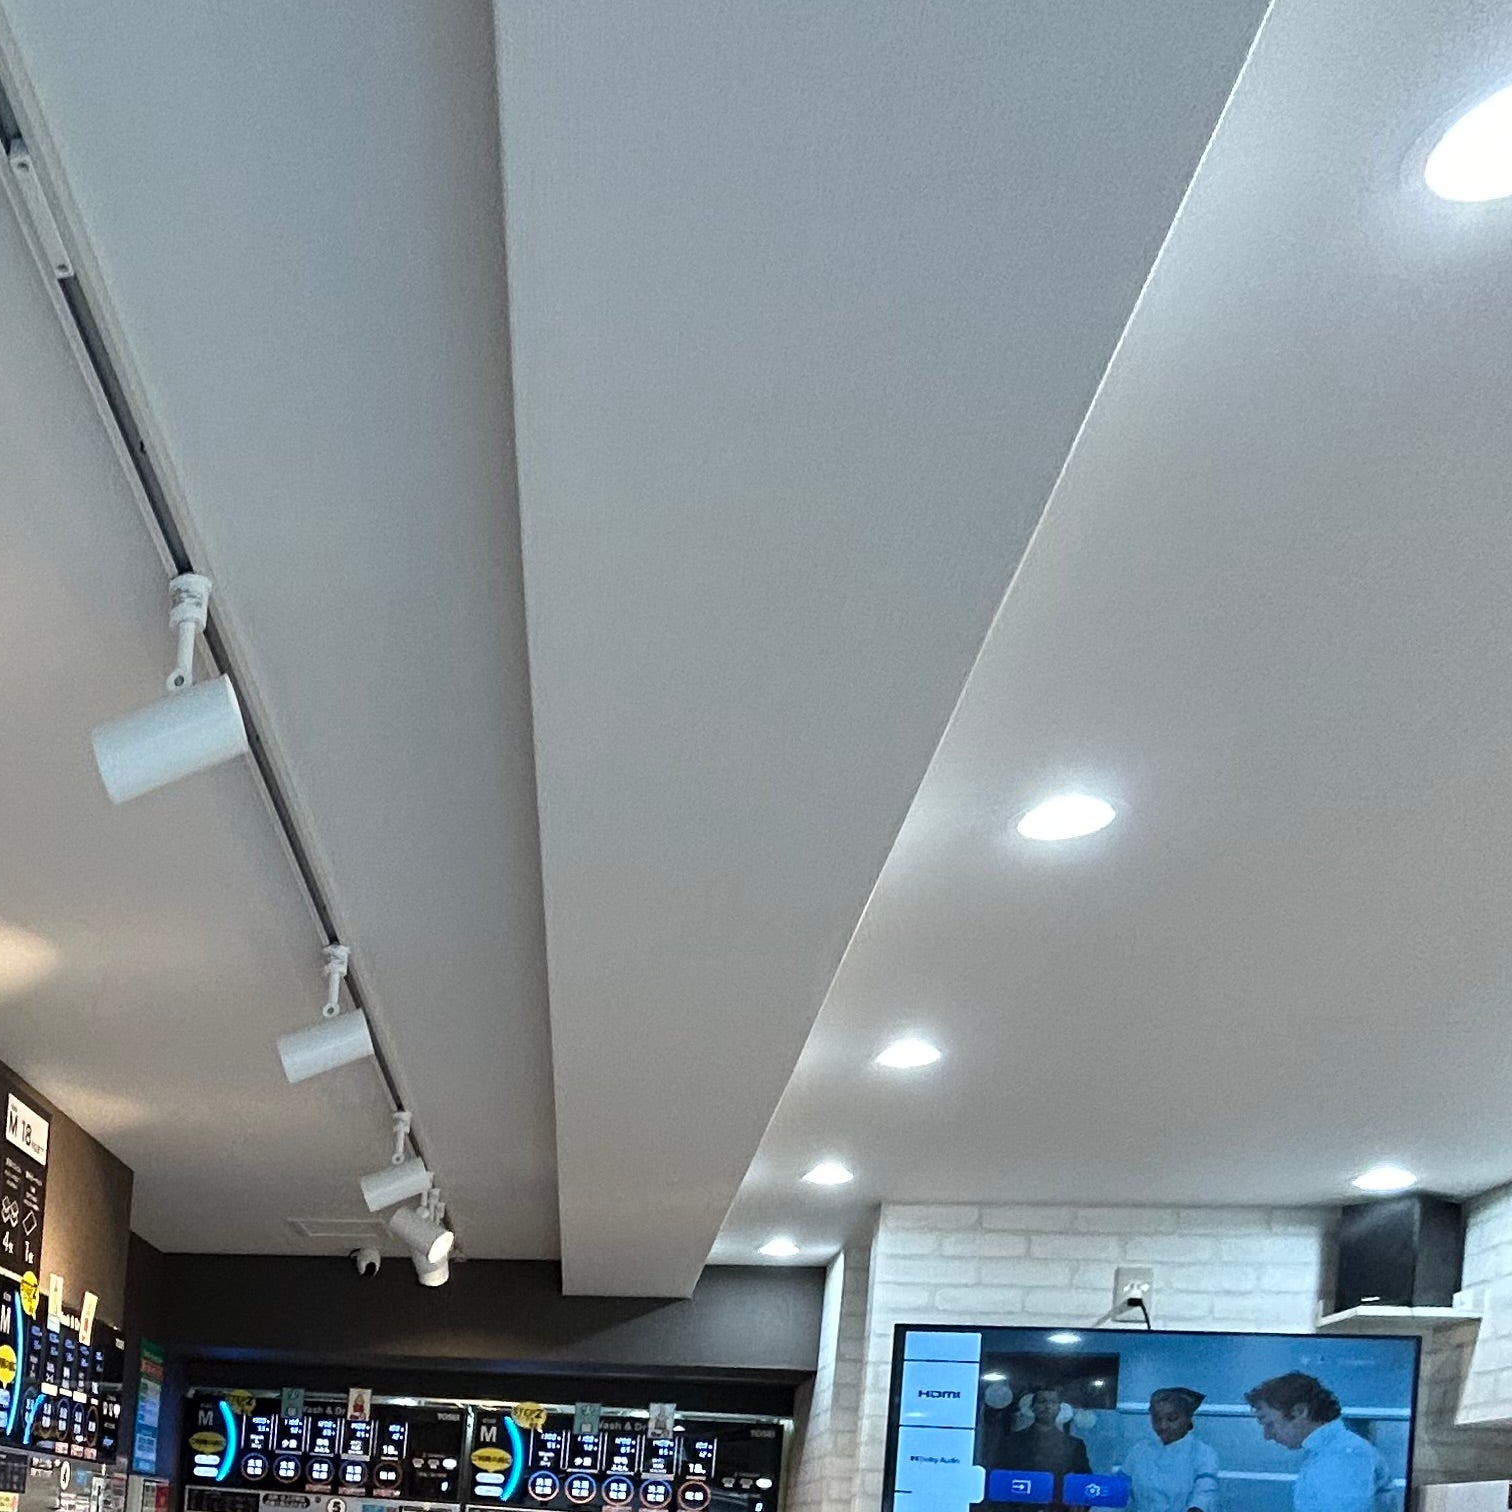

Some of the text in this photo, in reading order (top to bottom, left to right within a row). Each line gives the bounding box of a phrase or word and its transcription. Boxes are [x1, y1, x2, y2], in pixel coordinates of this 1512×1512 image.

[0, 1304, 11, 1334] M
[918, 1390, 960, 1399] HDMI
[198, 1411, 214, 1426] M
[480, 1426, 497, 1442] M
